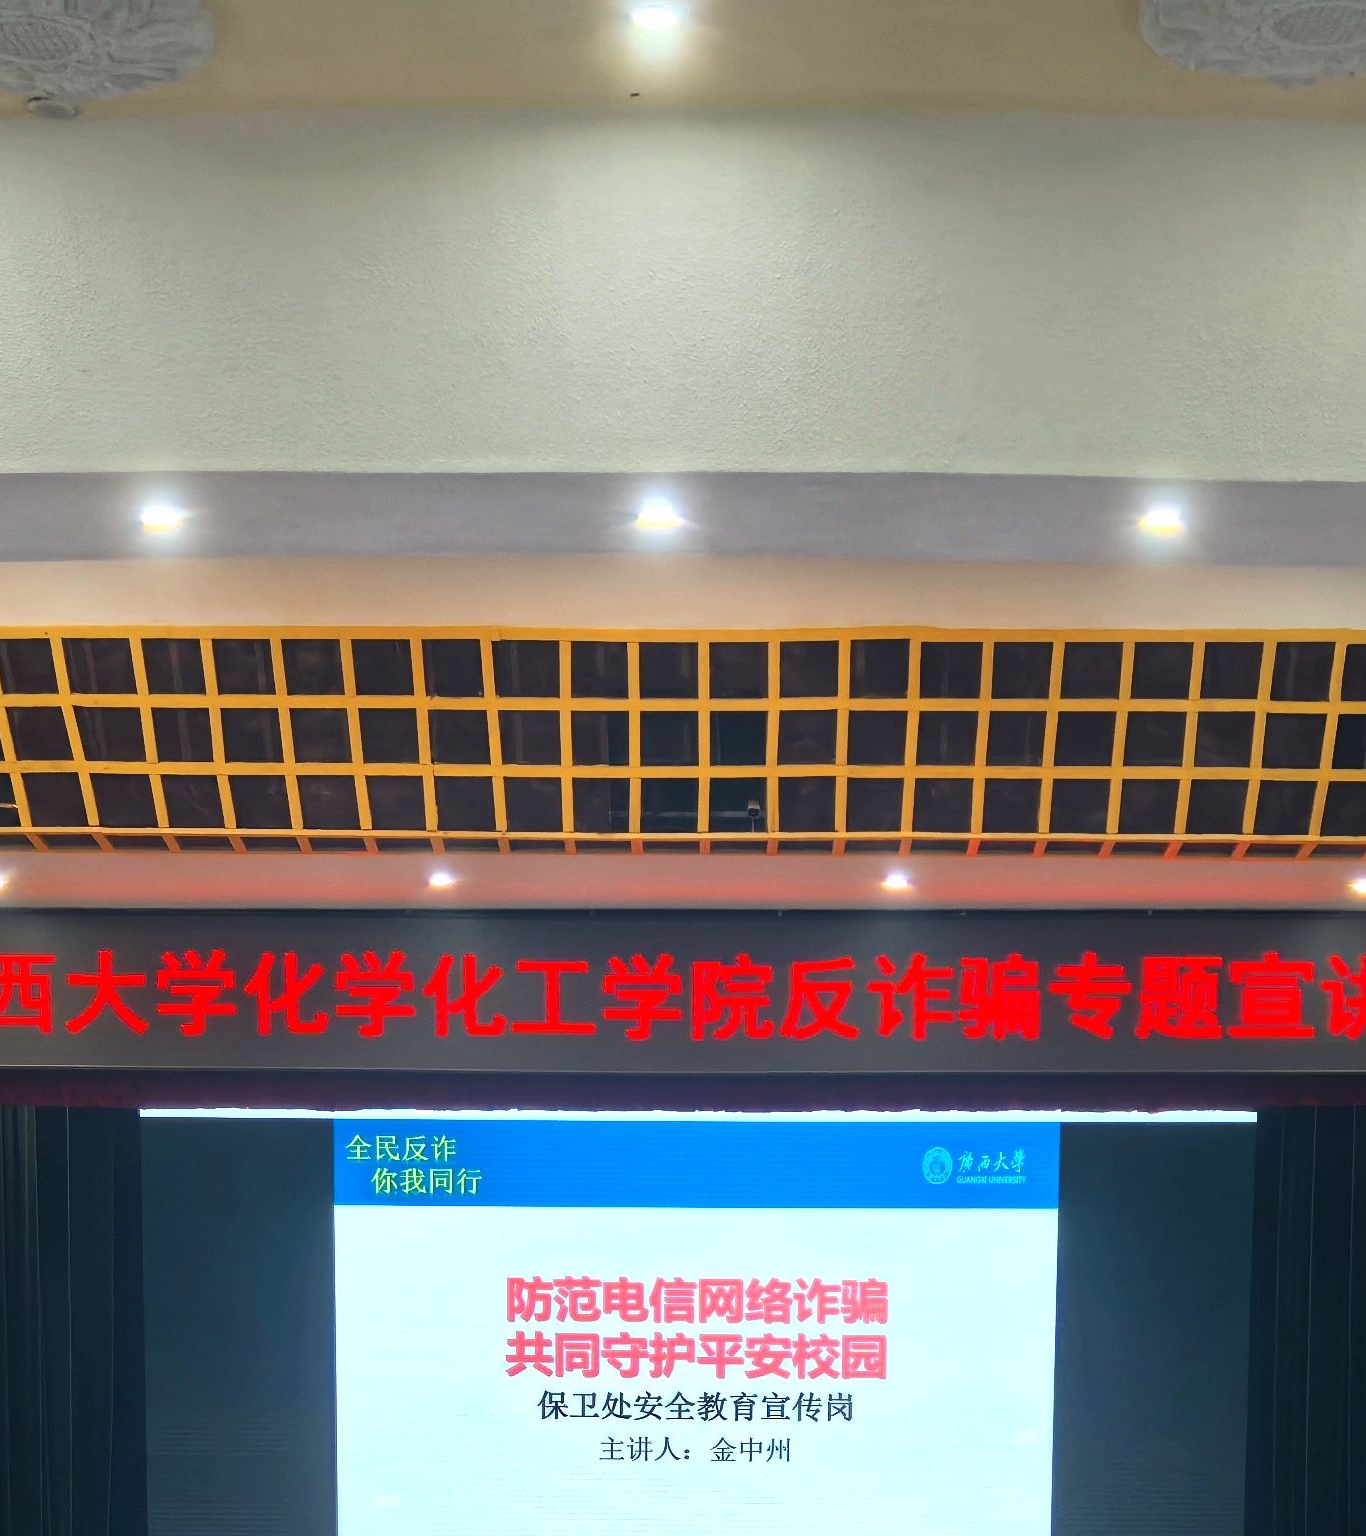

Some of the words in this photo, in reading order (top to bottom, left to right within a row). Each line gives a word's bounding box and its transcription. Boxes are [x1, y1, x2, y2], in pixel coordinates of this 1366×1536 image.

[345, 1134, 457, 1163] 全民反诈
[370, 1167, 483, 1196] 你我同行
[505, 1275, 889, 1326] 防范电信网络诈骗
[505, 1332, 889, 1382] 共同守护平安校园
[536, 1390, 856, 1426] 保卫处安全教育宣传岗
